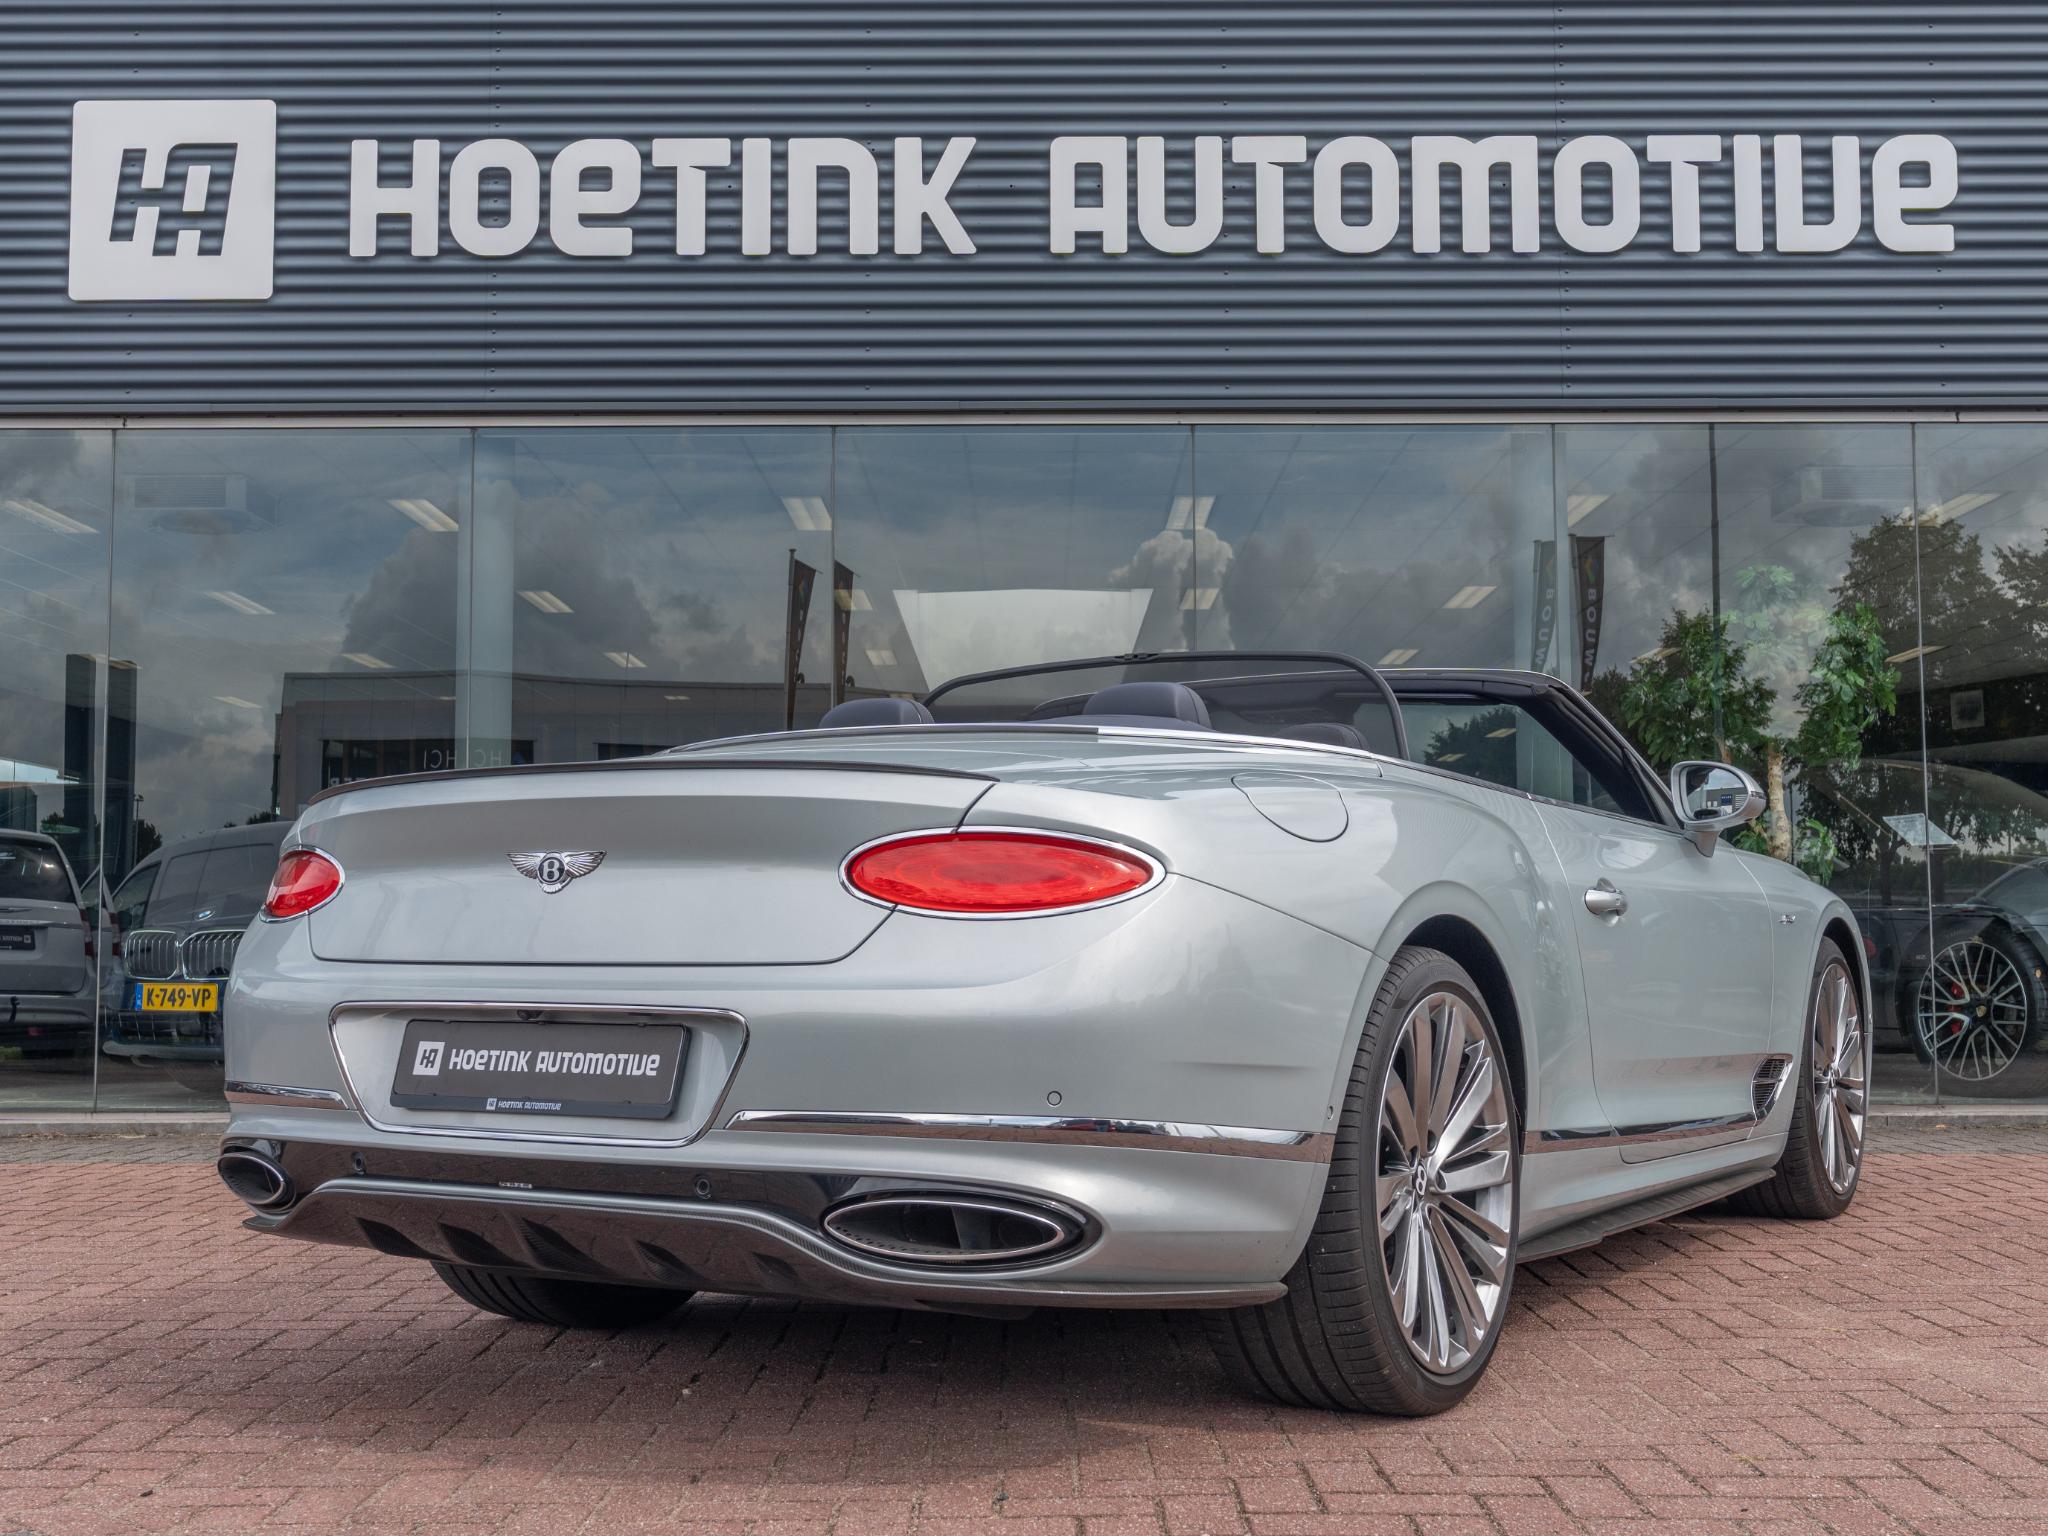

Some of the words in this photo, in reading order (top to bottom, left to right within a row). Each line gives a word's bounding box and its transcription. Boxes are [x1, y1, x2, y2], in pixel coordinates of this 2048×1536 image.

[349, 137, 977, 257] HOETINK
[1049, 134, 1958, 253] AUTOMOTIVE
[543, 859, 560, 880] B
[146, 988, 211, 1008] K-749-VP
[449, 1048, 532, 1072] HOETINK
[535, 1051, 660, 1076] AUTOMOTIVE
[498, 1101, 523, 1109] HOETINK
[524, 1101, 561, 1110] AUTOMOTIVE
